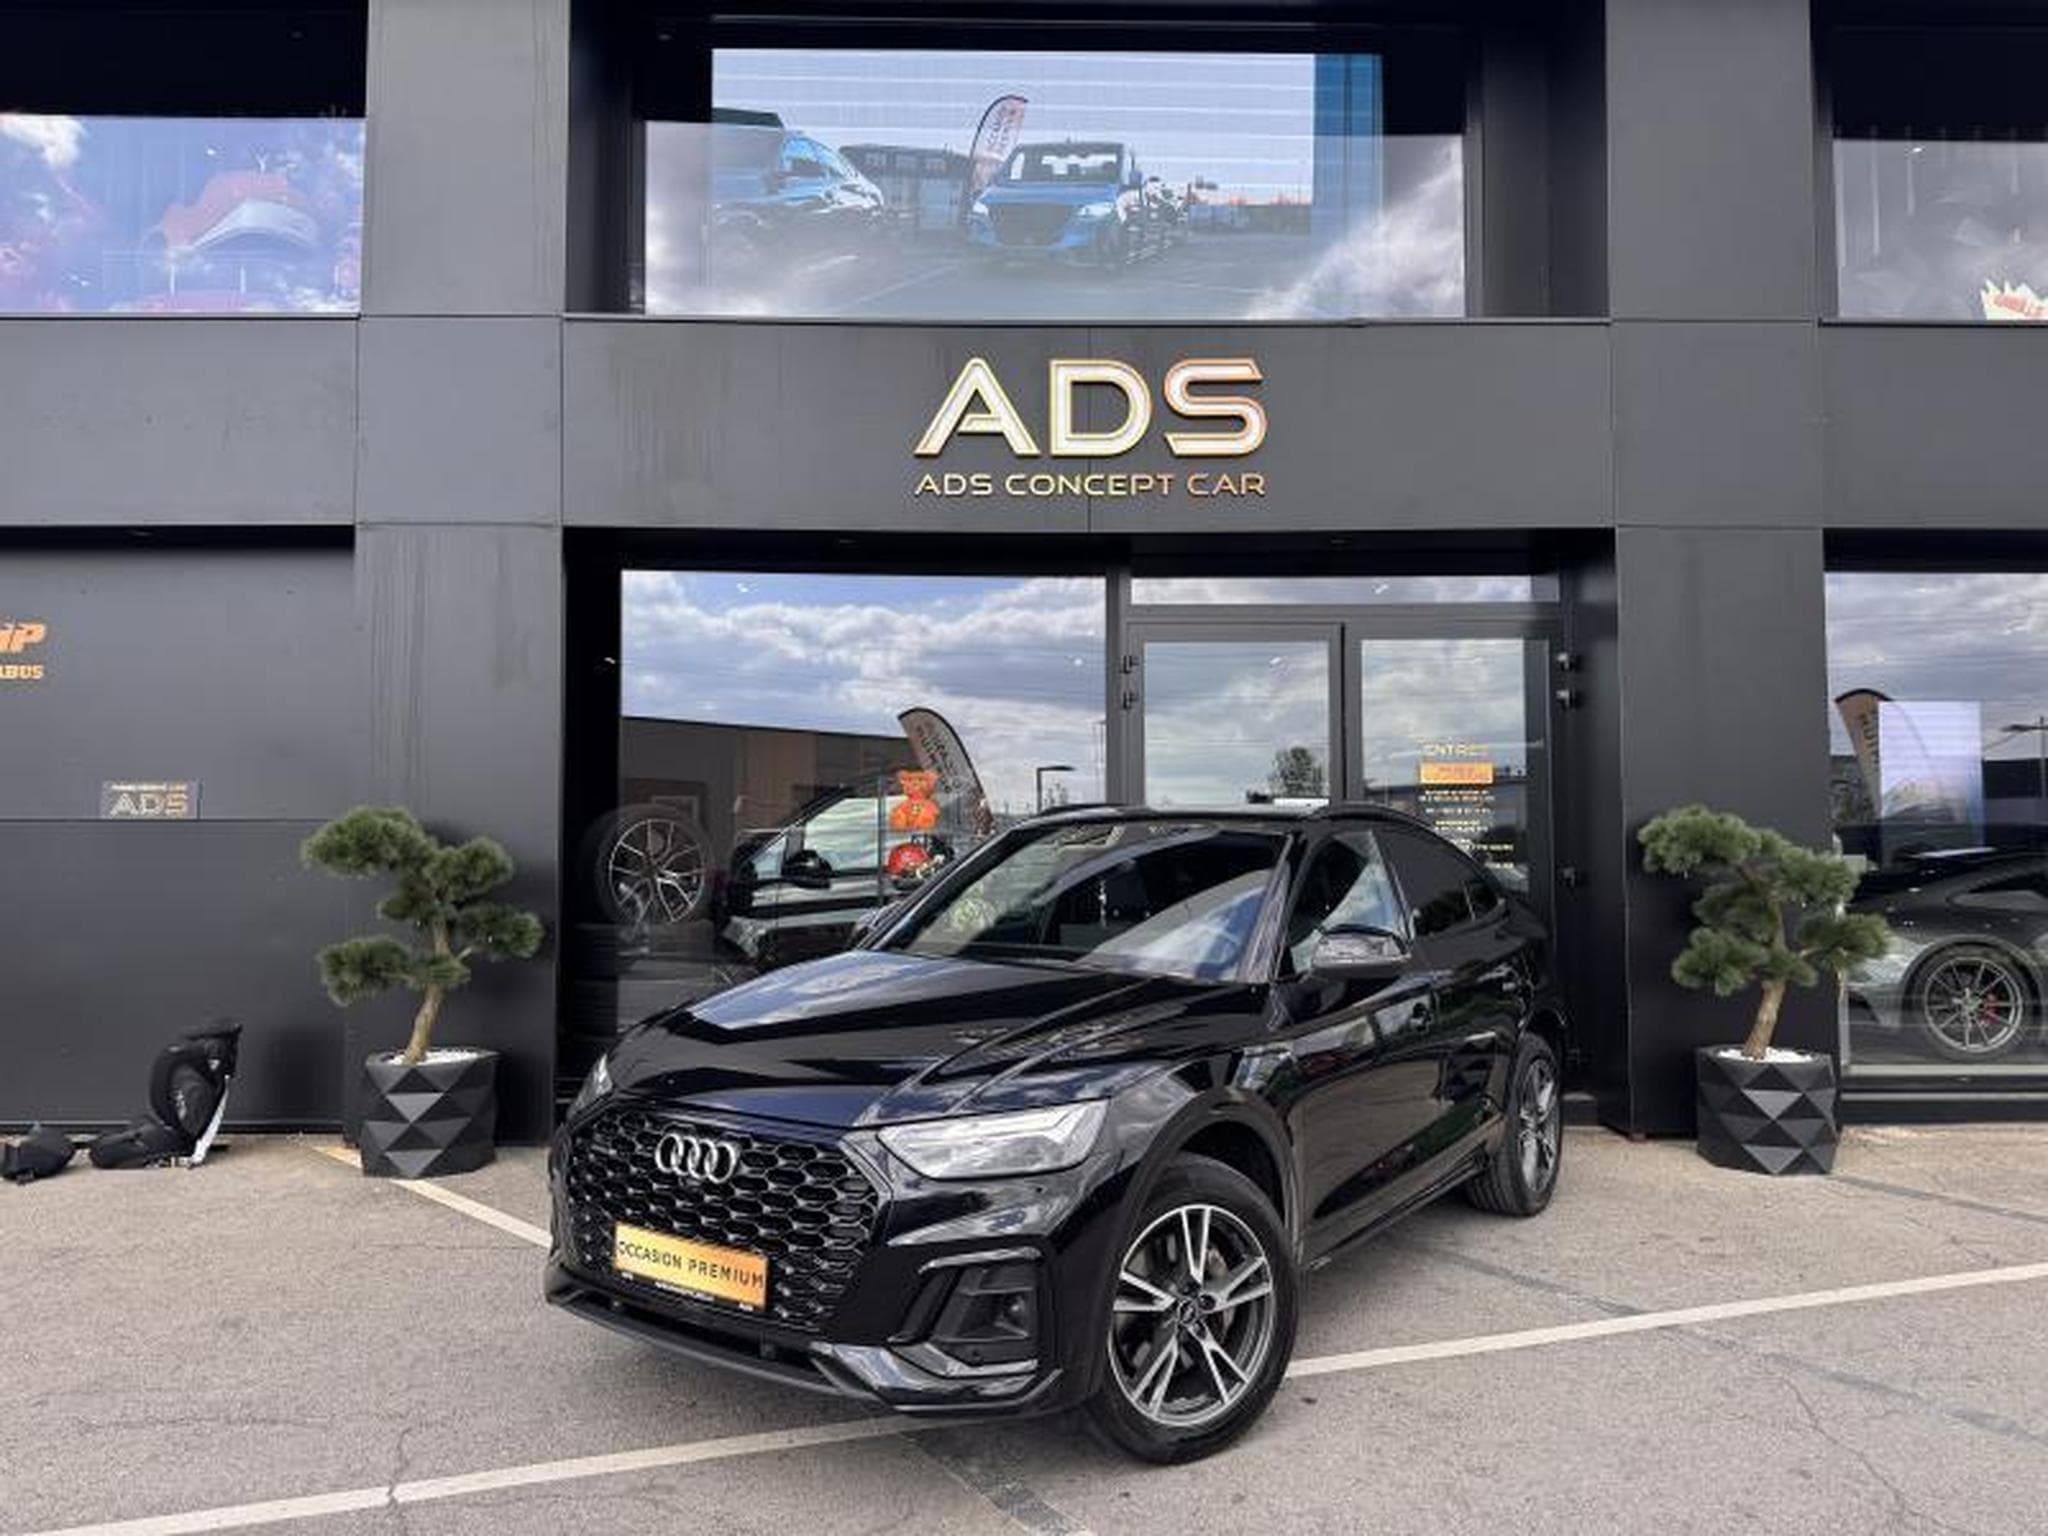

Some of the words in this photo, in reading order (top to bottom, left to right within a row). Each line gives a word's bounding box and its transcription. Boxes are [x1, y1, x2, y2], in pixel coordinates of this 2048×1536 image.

[914, 357, 1268, 457] ADS
[914, 473, 994, 496] ADS
[1005, 473, 1175, 497] CONCEPT
[1187, 473, 1267, 498] CAR
[110, 792, 188, 817] ADS
[618, 1241, 683, 1270] OCCASION
[687, 1258, 764, 1289] PREMIUM
